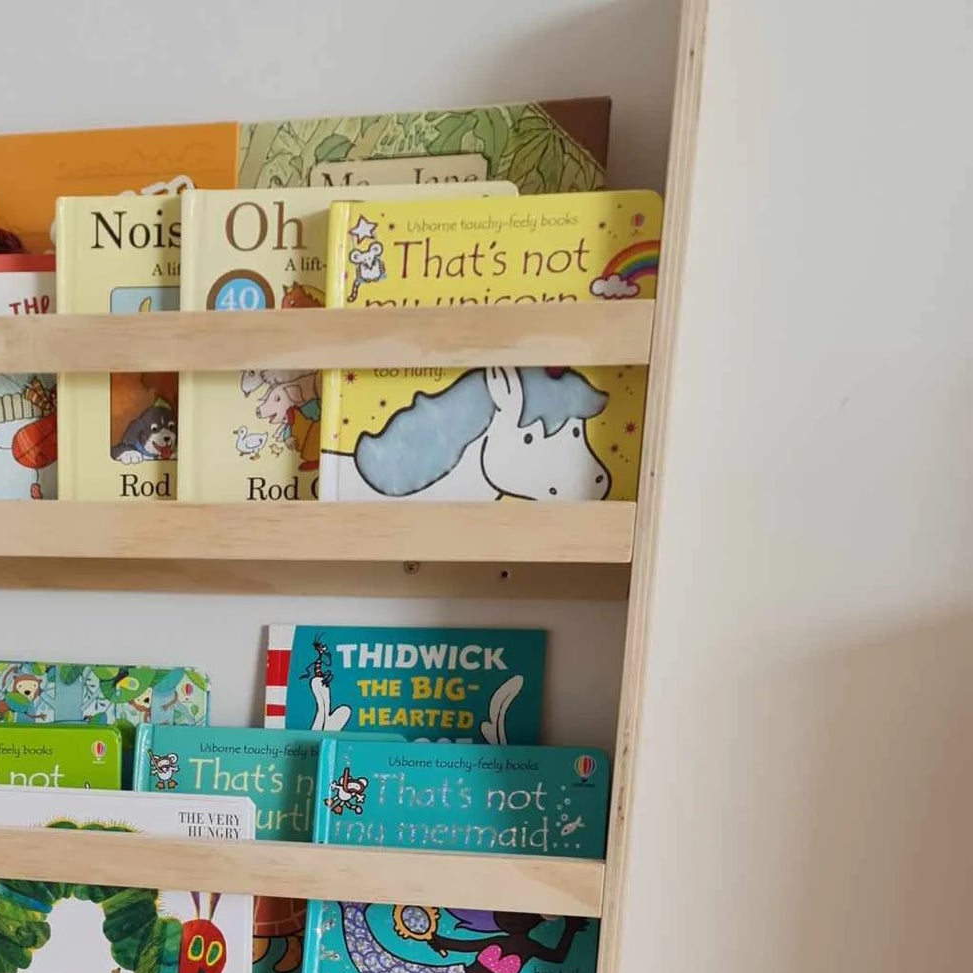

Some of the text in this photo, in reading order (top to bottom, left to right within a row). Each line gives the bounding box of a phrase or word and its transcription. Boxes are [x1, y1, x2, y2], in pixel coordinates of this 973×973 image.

[225, 200, 308, 251] Oh
[406, 213, 579, 235] Usborne touchy-feely books
[151, 262, 164, 276] A
[284, 258, 297, 272] A
[393, 237, 591, 280] That's not
[219, 286, 261, 309] 40
[119, 473, 171, 498] Rod
[246, 476, 301, 500] Rod
[336, 643, 509, 670] THIDWICK
[356, 676, 480, 700] THE BIG-
[358, 707, 474, 729] HEARTED
[22, 744, 54, 757] books
[199, 743, 241, 756] Usborne
[9, 764, 66, 788] not
[188, 756, 283, 794] That's
[388, 756, 540, 773] Usborne touchy-feely books
[374, 771, 548, 812] That's not
[178, 811, 242, 827] THE VERY
[187, 825, 242, 840] HUNGRY
[332, 819, 385, 848] my
